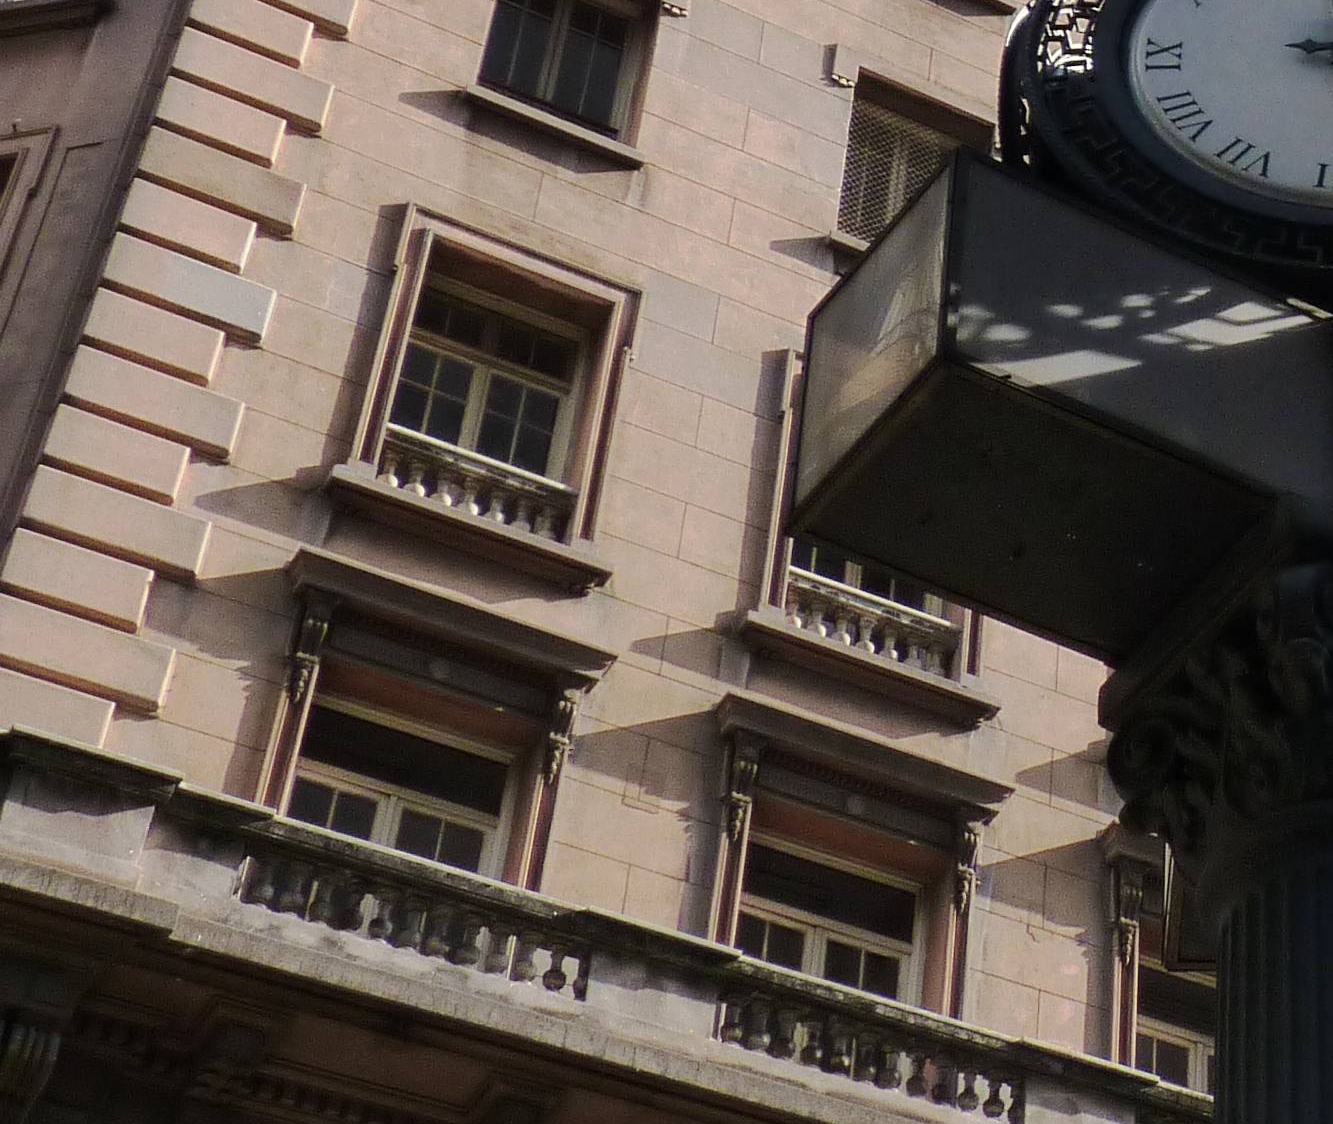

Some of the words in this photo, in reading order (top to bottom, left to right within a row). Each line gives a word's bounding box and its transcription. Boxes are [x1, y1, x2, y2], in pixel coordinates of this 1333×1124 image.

[1145, 38, 1183, 72] IX
[1156, 90, 1213, 143] VIII
[1213, 136, 1270, 178] VII
